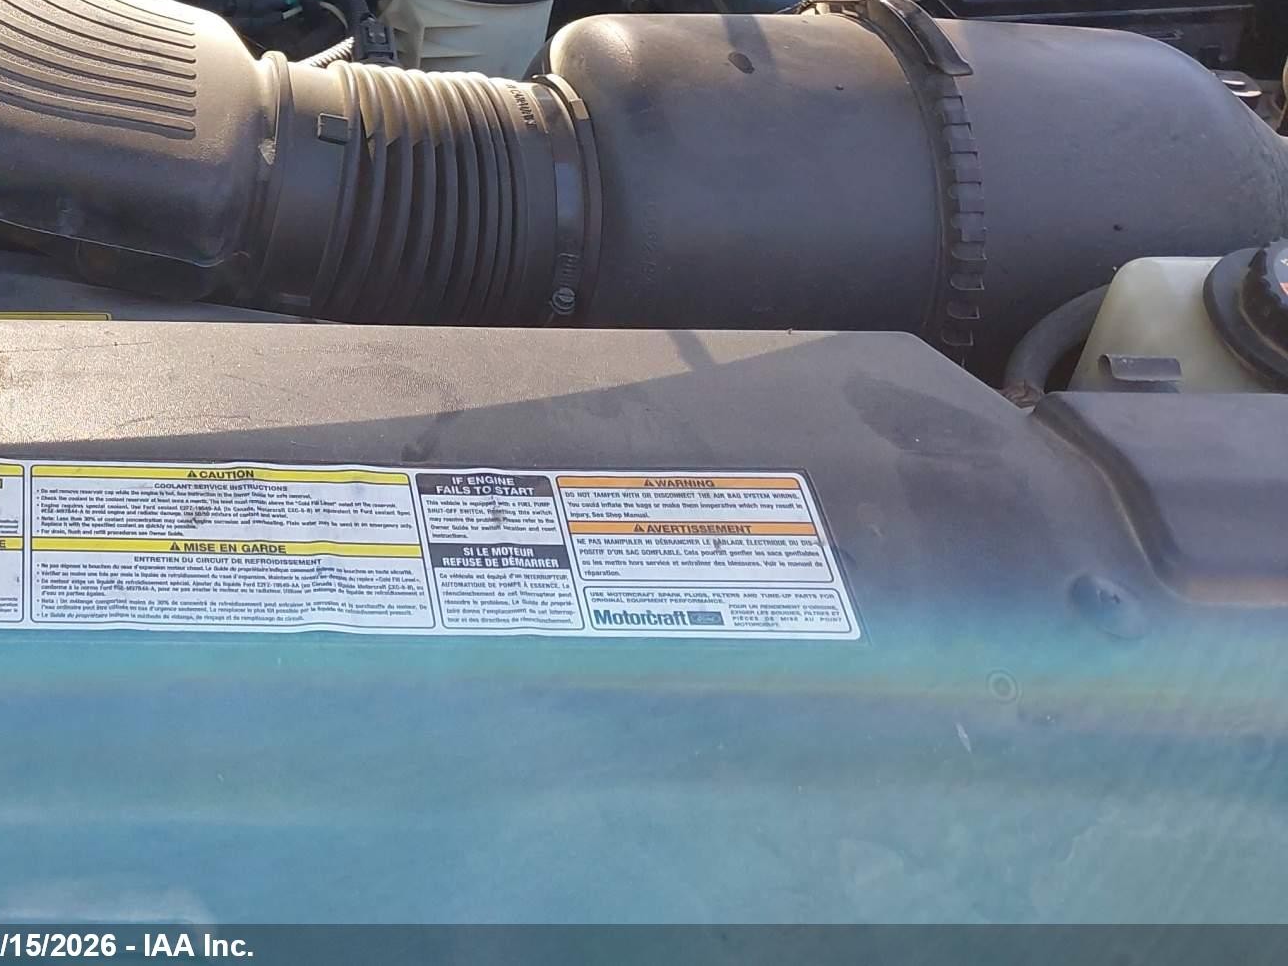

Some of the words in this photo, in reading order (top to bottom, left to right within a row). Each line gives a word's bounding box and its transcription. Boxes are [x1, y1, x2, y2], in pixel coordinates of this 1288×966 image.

[198, 470, 255, 480] CAUTION
[452, 476, 464, 485] IF
[467, 476, 516, 486] ENGINE
[655, 479, 716, 488] WARNING
[154, 482, 192, 490] COOLANT
[193, 483, 229, 491] SERVICE
[229, 483, 288, 494] INSTRUCTIONS
[436, 486, 471, 494] FAILS
[473, 486, 492, 494] TO
[494, 487, 535, 496] START
[646, 524, 753, 534] AVERTISSEMENT
[184, 542, 216, 552] MISE
[220, 544, 238, 553] EN
[241, 544, 287, 554] GARDE
[463, 547, 474, 556] SI
[476, 548, 489, 557] LE
[492, 548, 534, 558] MOTEUR
[182, 556, 194, 564] DU
[244, 558, 323, 566] REFROIDISSEMENT
[442, 558, 482, 566] REFUSE
[483, 558, 499, 567] DE
[501, 556, 560, 568] DÉMARRER
[593, 609, 688, 626] Motorcraft
